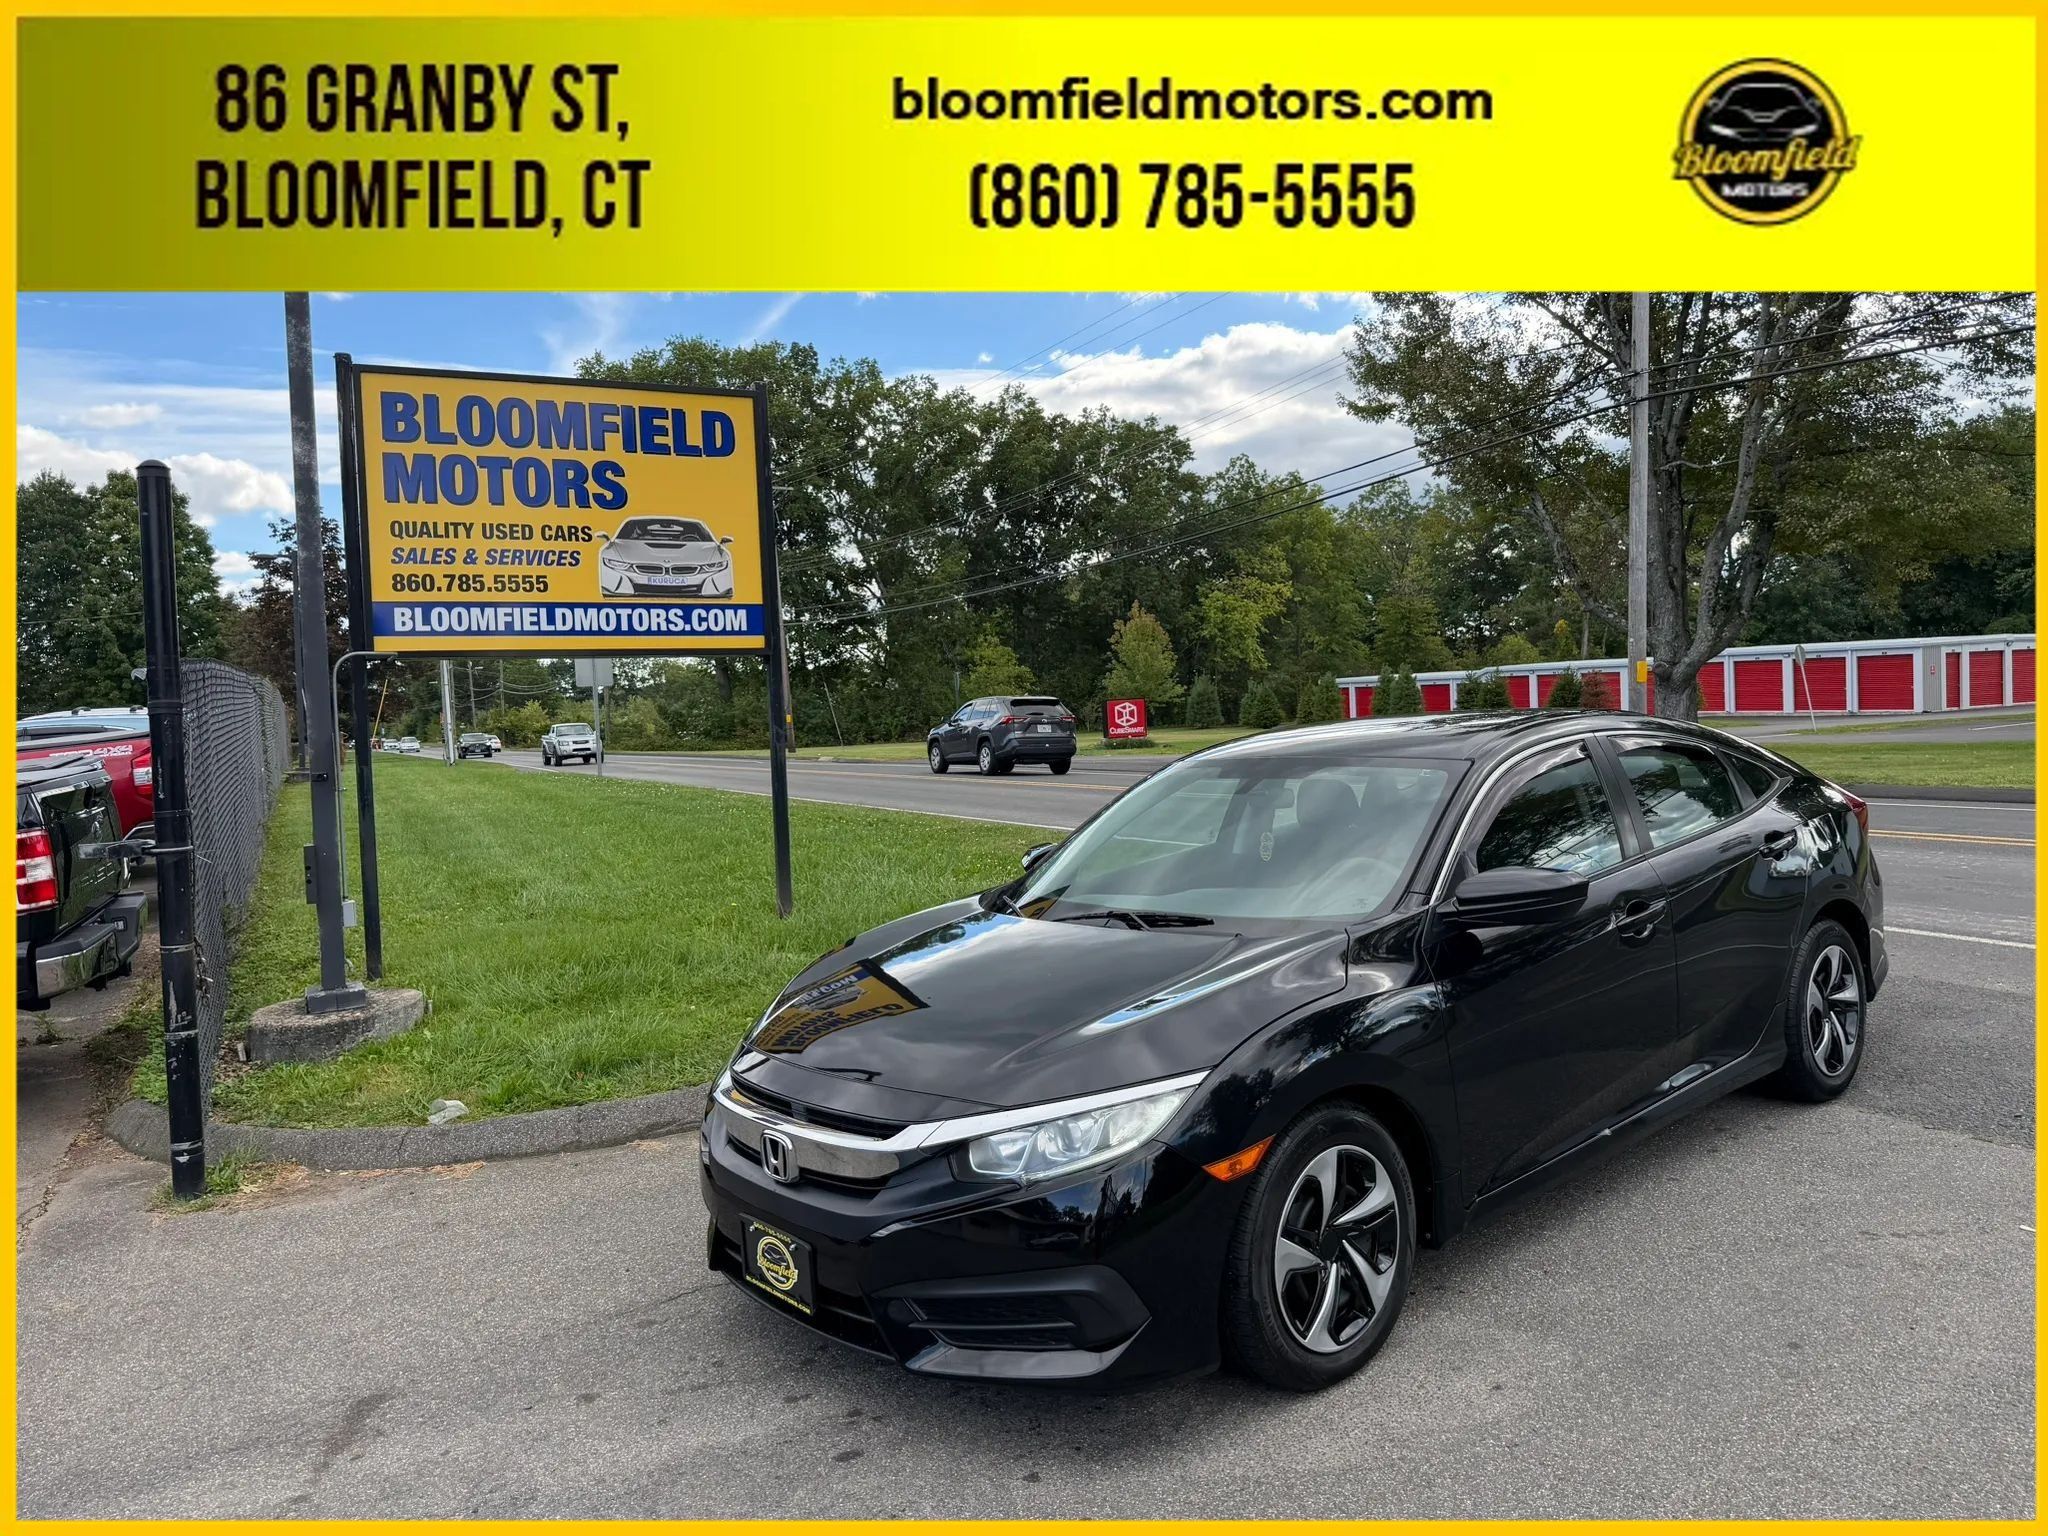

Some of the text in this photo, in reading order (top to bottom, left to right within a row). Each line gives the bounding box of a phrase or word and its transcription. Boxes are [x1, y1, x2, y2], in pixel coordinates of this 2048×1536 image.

[379, 391, 736, 457] BLOOMFIELD
[382, 451, 628, 510] MOTORS
[389, 520, 593, 543] QUALITY USED CARS
[390, 547, 582, 567] SALES & SERVICES
[391, 573, 549, 594] 860.785.5555
[393, 606, 748, 632] BLOOMFIELDMOTORS.COM
